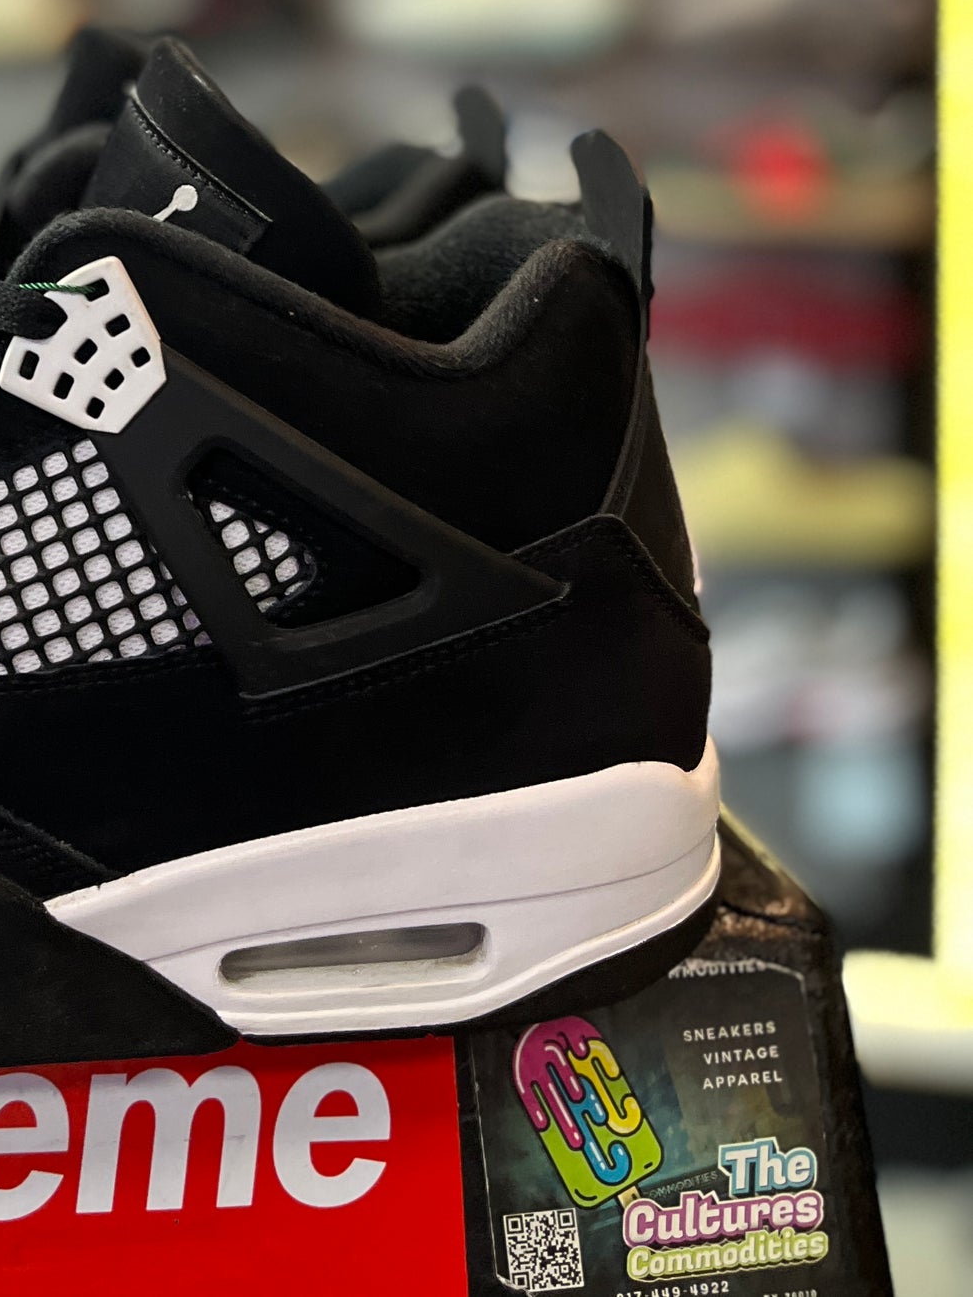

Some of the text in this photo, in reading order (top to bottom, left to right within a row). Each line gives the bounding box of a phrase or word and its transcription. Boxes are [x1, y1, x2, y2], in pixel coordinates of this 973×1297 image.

[682, 1020, 776, 1042] SNEAKERS
[703, 1045, 780, 1065] VINTAGE
[702, 1070, 783, 1090] APPAREL
[724, 1143, 813, 1191] The
[627, 1195, 819, 1244] Cultures
[630, 1230, 825, 1277] Commodities
